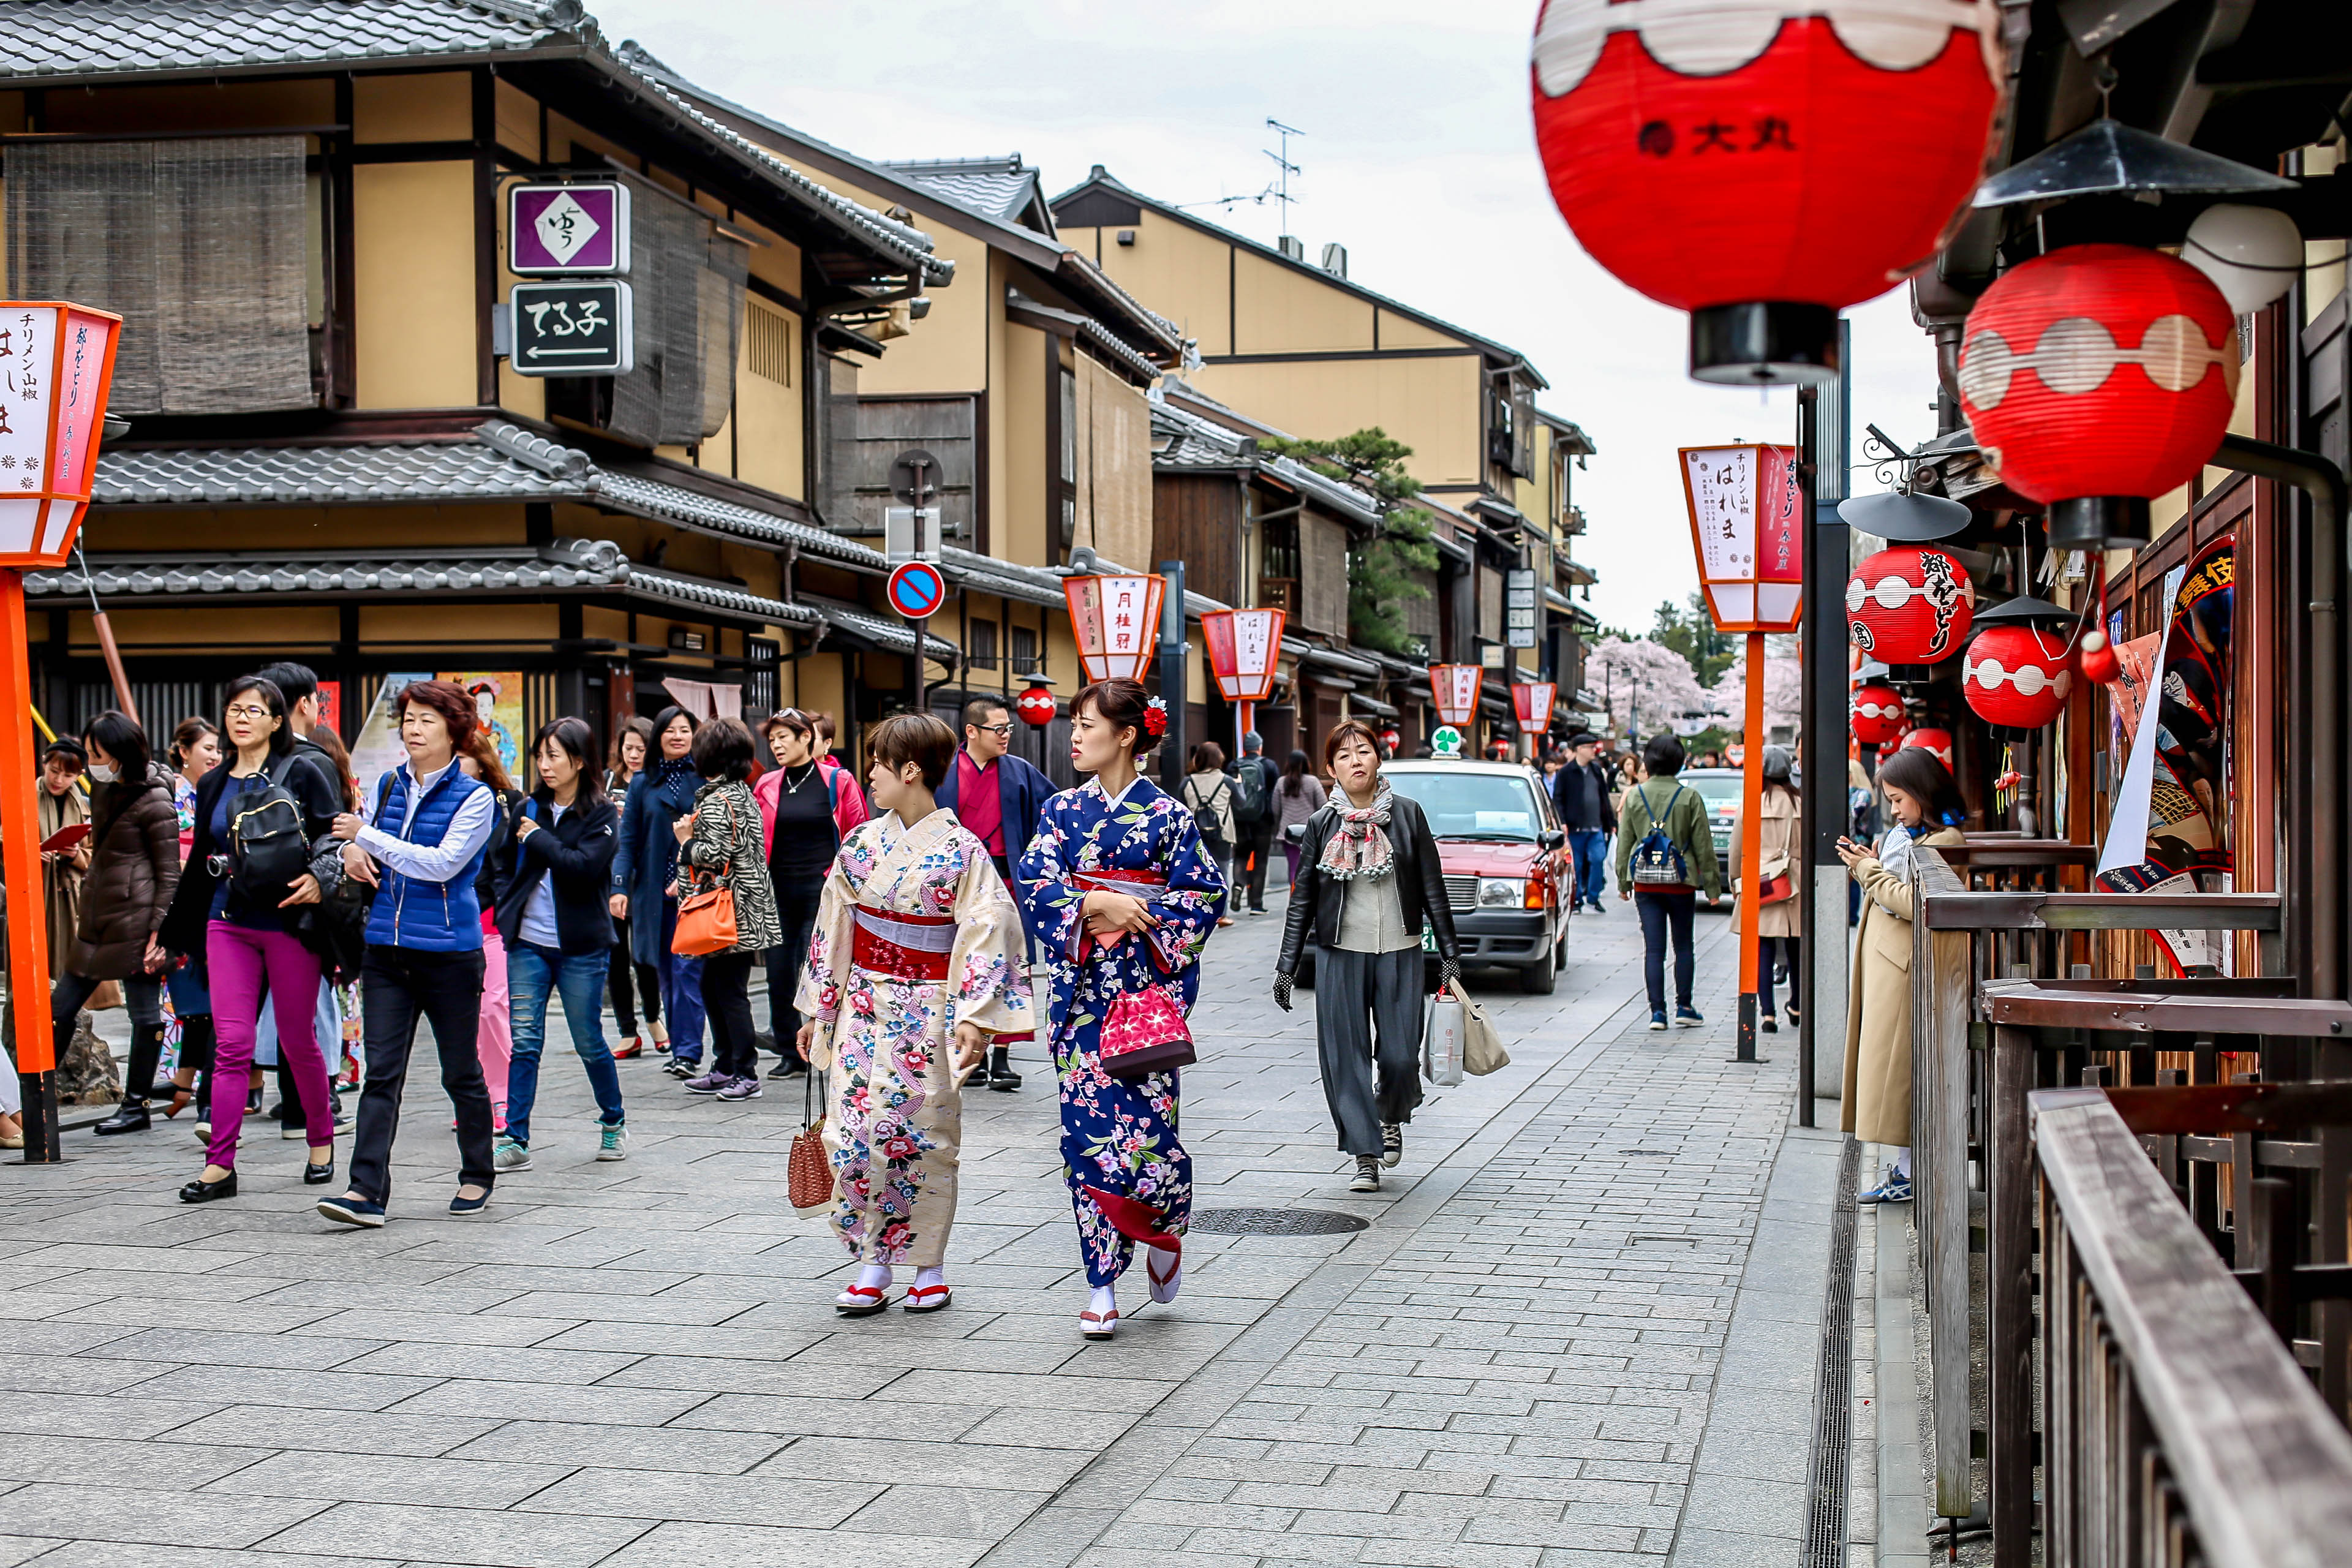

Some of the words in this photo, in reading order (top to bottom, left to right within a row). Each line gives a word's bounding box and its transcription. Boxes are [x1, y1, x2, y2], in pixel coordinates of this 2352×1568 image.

[1691, 115, 1798, 155] 大丸
[20, 313, 38, 401] チリメン山椒
[1716, 464, 1736, 540] はれま
[1736, 453, 1750, 516] チリメン山椒
[1114, 592, 1132, 649] 月桂冠
[1919, 551, 1958, 658] 都をどり
